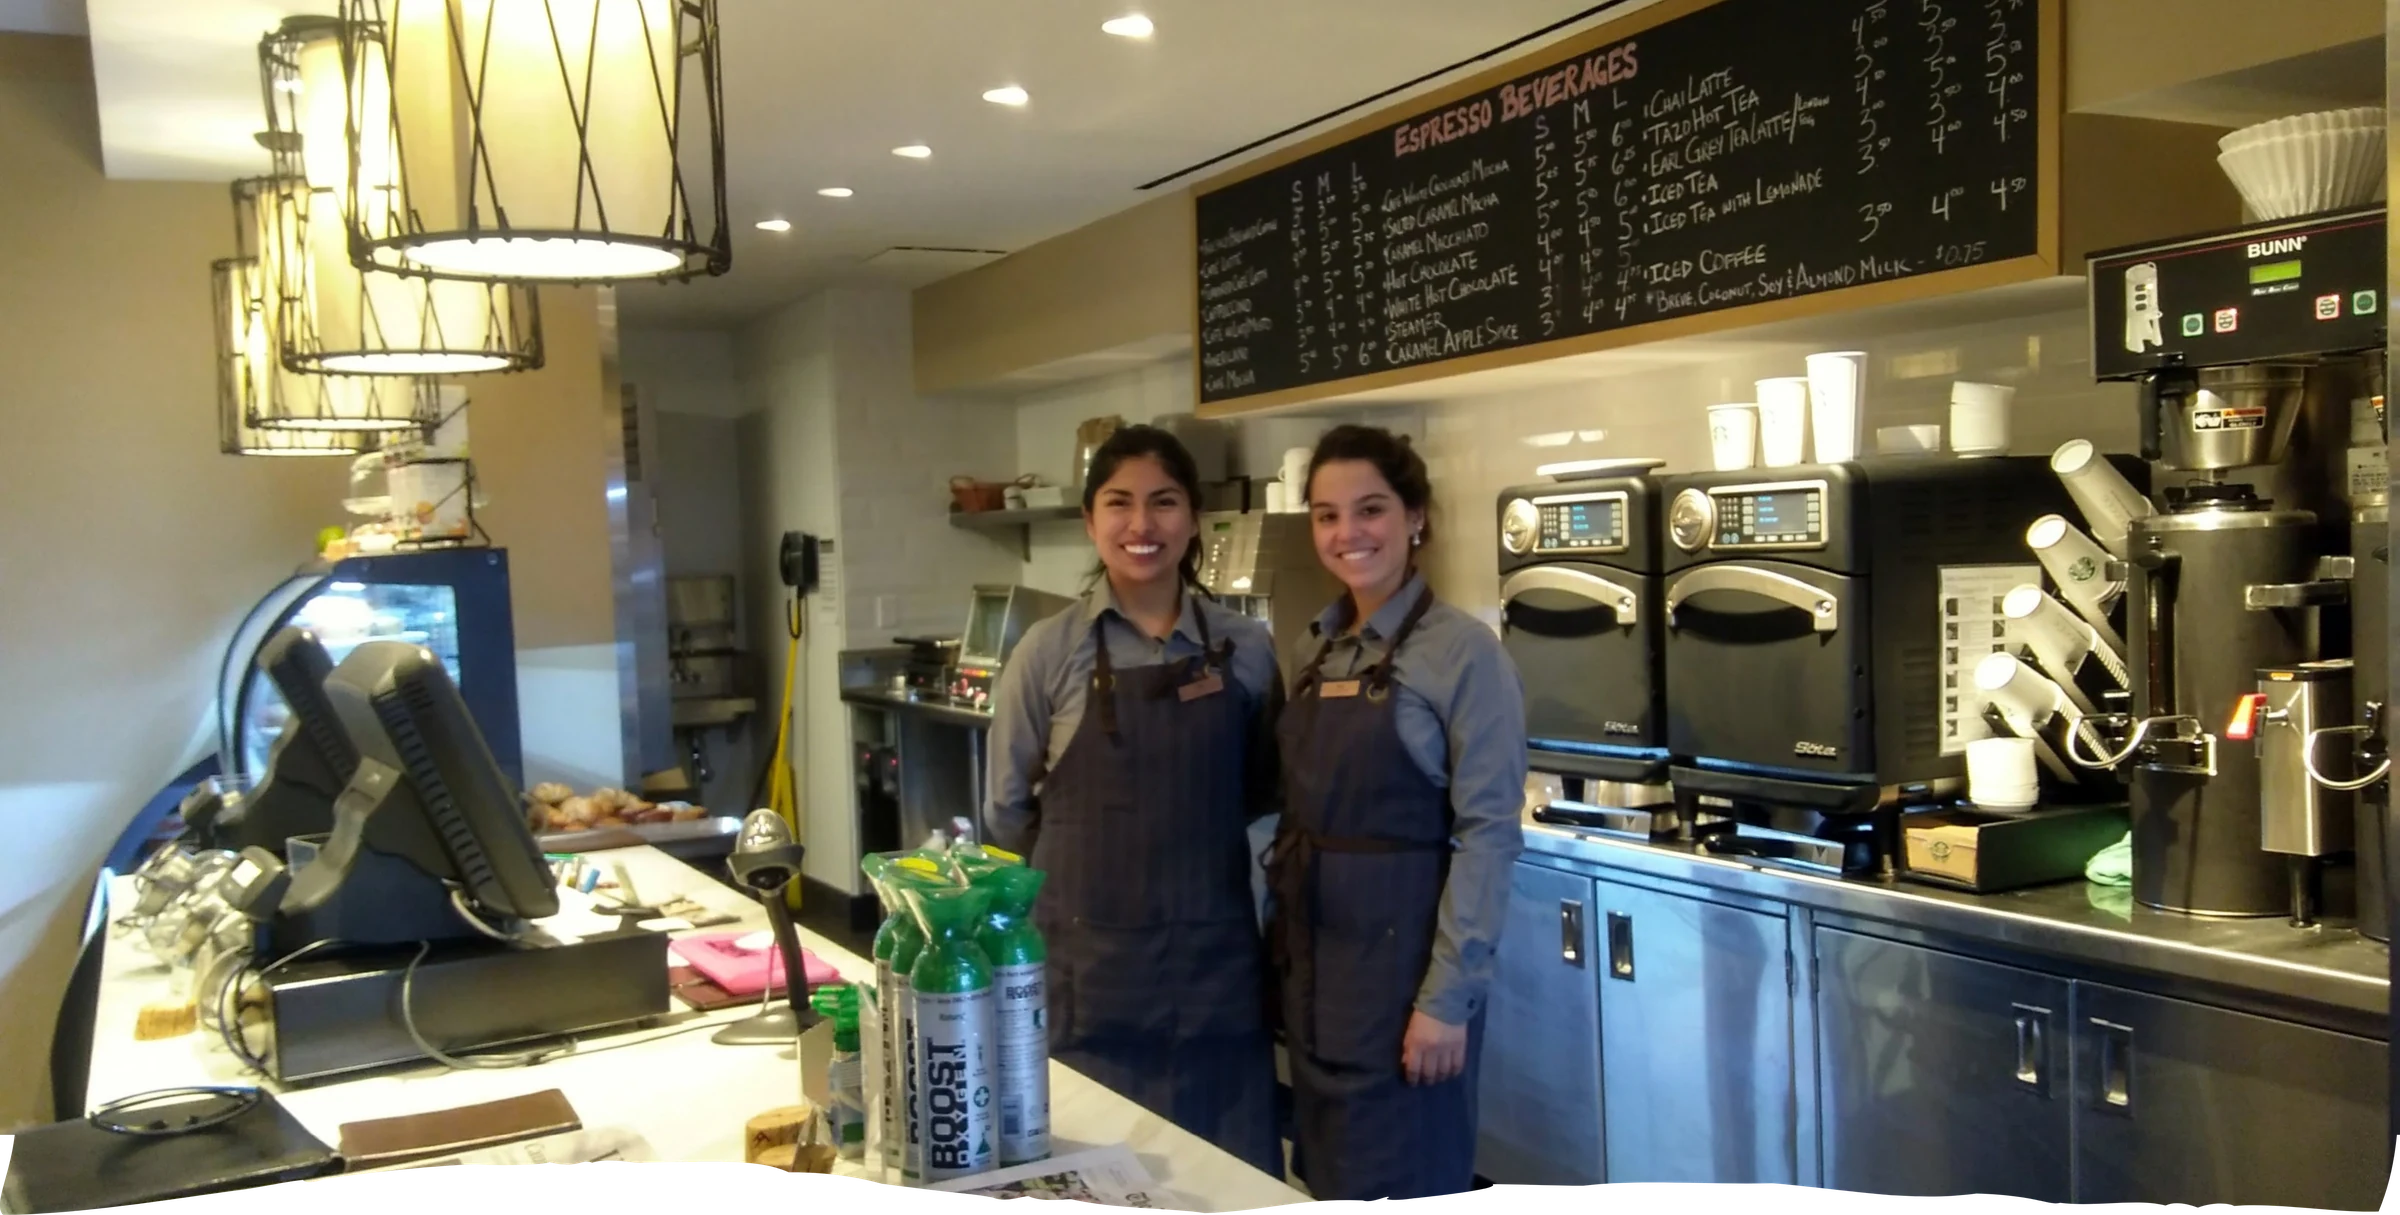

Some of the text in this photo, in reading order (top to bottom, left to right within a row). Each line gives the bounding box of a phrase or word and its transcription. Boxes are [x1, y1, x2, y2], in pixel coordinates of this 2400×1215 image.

[1395, 42, 1638, 158] ESPRESSO BEVERAGES
[1650, 89, 1685, 118] CHAI
[1688, 66, 1733, 104] LATTE
[1535, 87, 1628, 140] S M L
[1648, 122, 1690, 146] TAZO
[1692, 105, 1725, 132] HOT
[1721, 84, 1760, 117] TEA
[1651, 149, 1684, 178] EARL
[1685, 135, 1724, 164] GREY
[1723, 120, 1749, 154] TEA
[1318, 172, 1330, 196] M
[1352, 162, 1363, 182] L
[1648, 183, 1684, 205] ICED
[1684, 170, 1719, 195] TEA
[1650, 211, 1687, 235] ICED
[1689, 201, 1716, 224] TEA
[1722, 191, 1752, 215] WITH
[1756, 168, 1823, 205] LEMONADE
[1410, 251, 1478, 283] CHOCOLATE
[1649, 260, 1693, 285] ICED
[1699, 244, 1767, 275] COFFEE
[2248, 236, 2302, 258] BUNN
[1448, 264, 1519, 300] CHOCOLATE
[1758, 272, 1783, 297] SOY
[1796, 262, 1856, 290] ALMOND
[1860, 255, 1913, 280] MILK
[1388, 312, 1447, 341] STEAMER
[1389, 338, 1442, 364] CARAMEL
[1443, 326, 1484, 355] APPLE
[927, 1037, 958, 1169] BOOST
